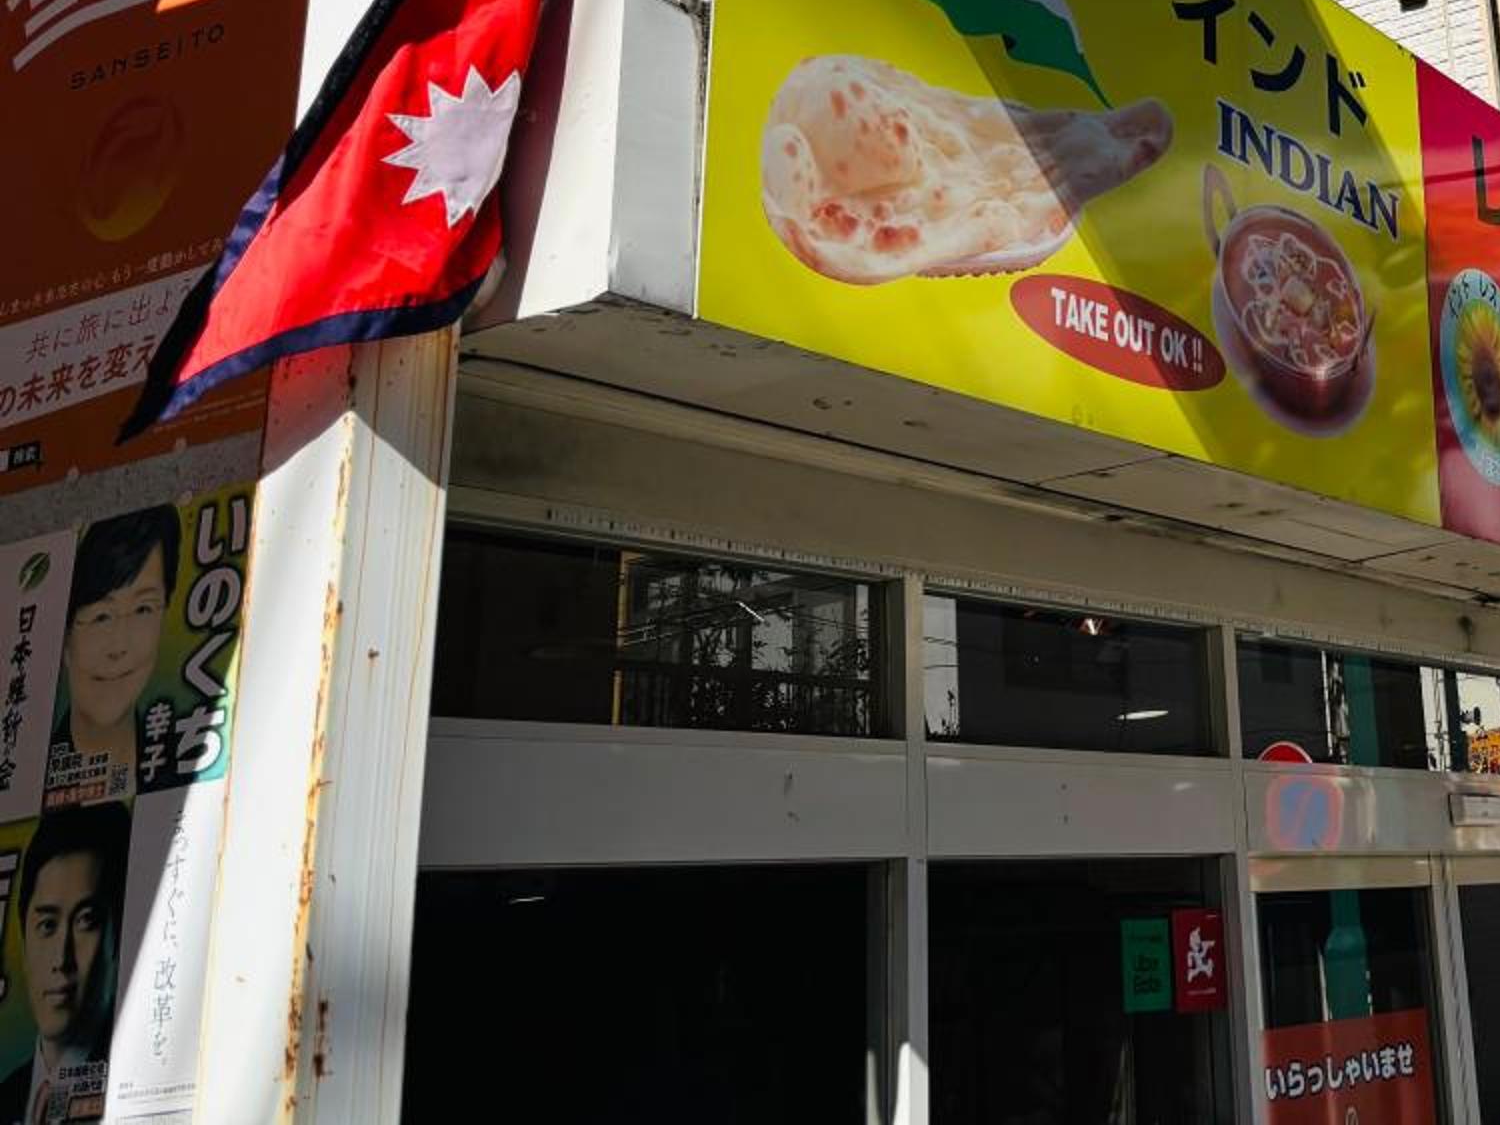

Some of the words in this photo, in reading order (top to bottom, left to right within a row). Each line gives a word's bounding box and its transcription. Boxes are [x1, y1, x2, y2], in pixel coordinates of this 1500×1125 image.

[68, 23, 226, 91] SANSEITO
[1216, 98, 1400, 242] INDIAN
[1050, 287, 1109, 343] TAKE
[1113, 312, 1155, 357] OUT
[1159, 331, 1188, 359] OK
[174, 496, 246, 776] いのくち
[138, 703, 173, 782] 幸子
[1263, 1041, 1415, 1101] いらっしゃいませ
